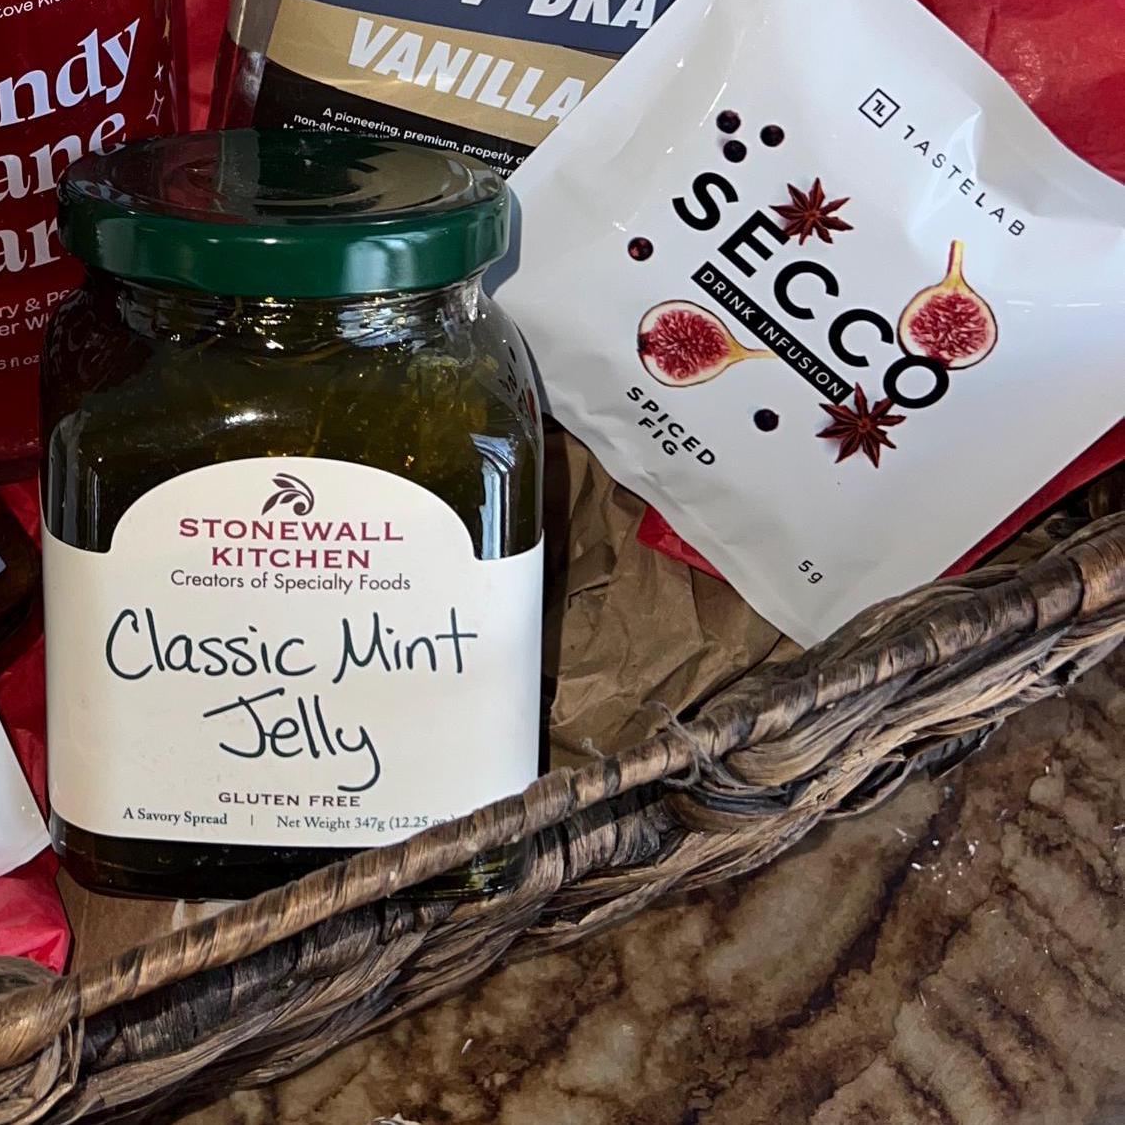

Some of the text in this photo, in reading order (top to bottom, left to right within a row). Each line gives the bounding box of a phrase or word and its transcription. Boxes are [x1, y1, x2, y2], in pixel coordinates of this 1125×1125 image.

[348, 17, 586, 123] VANILLA
[323, 108, 332, 118] A
[334, 110, 401, 138] pioneering,
[404, 130, 460, 152] premium,
[462, 143, 515, 165] properly
[903, 124, 1026, 237] TASTELAB
[25, 298, 40, 313] &
[671, 171, 950, 409] SECCO
[700, 269, 844, 398] DRINK INFUSION
[10, 356, 19, 367] fl
[626, 386, 716, 466] SPICED
[637, 417, 678, 457] FIG
[179, 518, 404, 542] STONEWALL
[212, 547, 370, 569] KITCHEN
[170, 570, 411, 595] Creators of Specialty Foods
[106, 607, 478, 683] Classic Mint
[203, 687, 380, 792] Jelly
[123, 808, 228, 829] A Savory Spread
[218, 792, 361, 808] GLUTEN FREE
[277, 816, 300, 828] Net
[304, 816, 350, 832] Weight
[354, 817, 385, 832] 347g
[389, 815, 428, 830] (12.25
